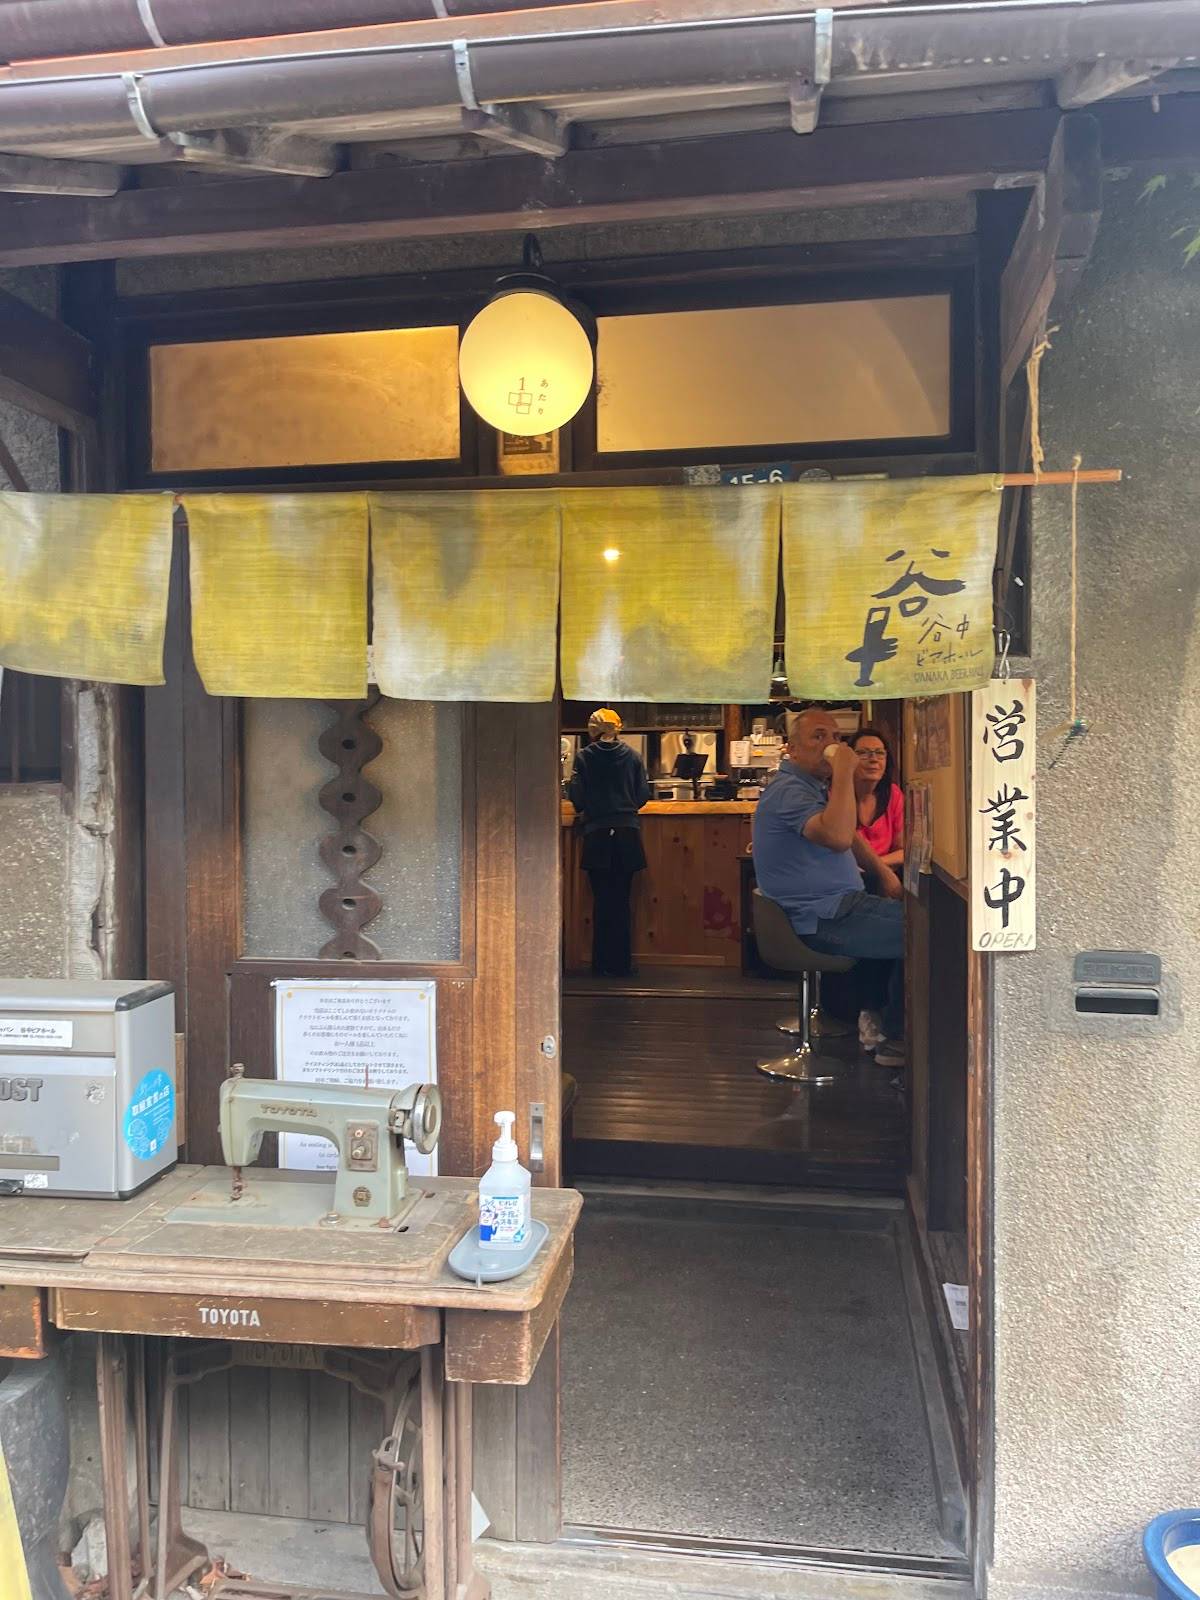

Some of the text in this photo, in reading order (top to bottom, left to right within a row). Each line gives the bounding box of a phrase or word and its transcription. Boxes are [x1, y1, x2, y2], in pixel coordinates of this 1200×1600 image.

[537, 378, 549, 415] あたり
[918, 613, 970, 645] 谷中
[914, 642, 984, 668] ビアホール
[978, 699, 1030, 929] 営業中
[979, 931, 1033, 949] OPEN
[260, 1103, 319, 1118] TOYOTA
[198, 1307, 261, 1327] TOYOTA
